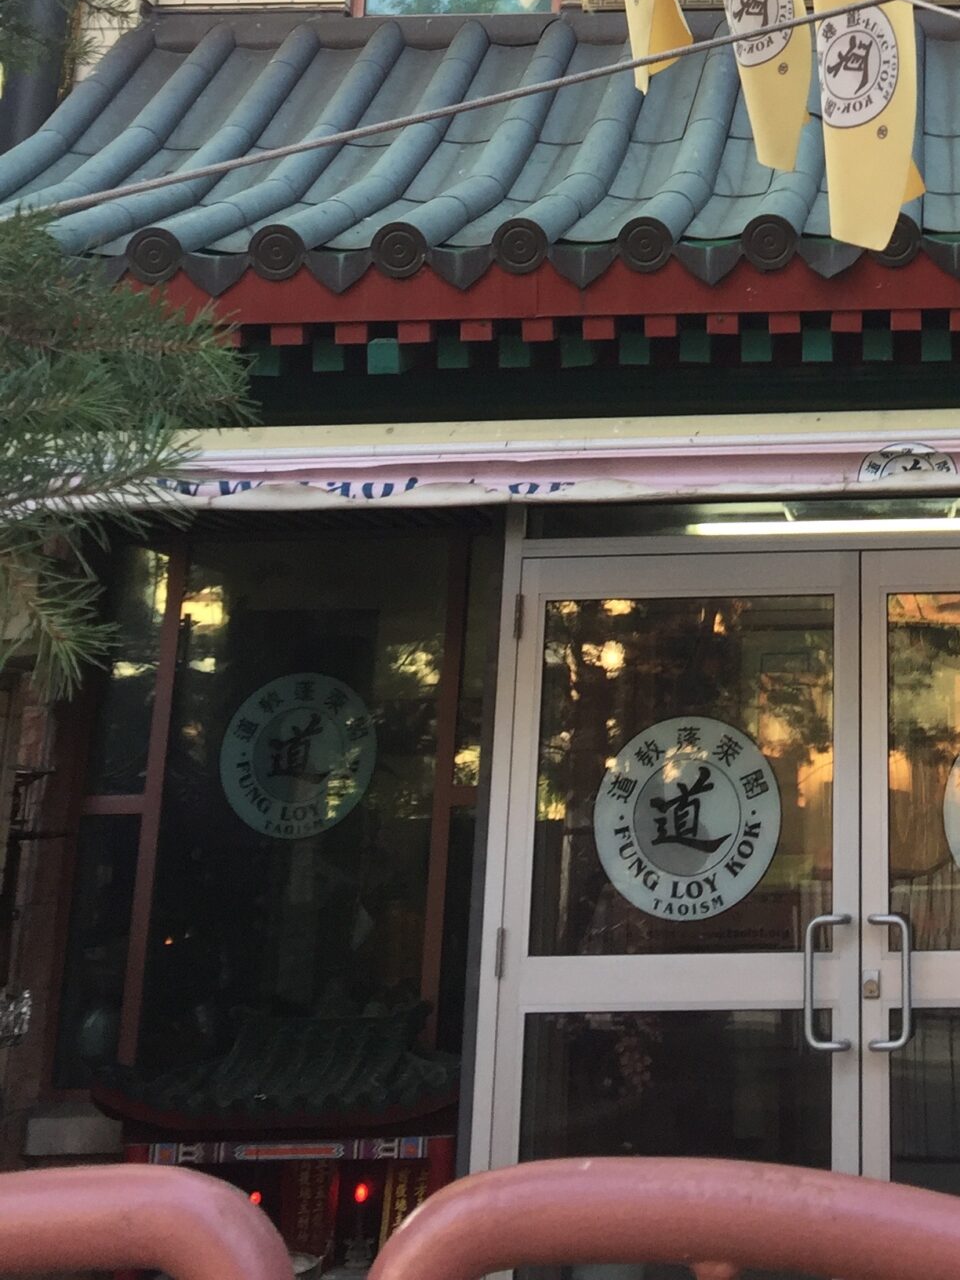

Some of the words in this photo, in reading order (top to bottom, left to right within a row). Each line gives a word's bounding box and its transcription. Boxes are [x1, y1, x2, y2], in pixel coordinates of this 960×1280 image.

[650, 766, 732, 853] 道
[614, 825, 660, 892] FUNG
[671, 873, 719, 899] LOY
[725, 820, 762, 878] KOK
[653, 895, 724, 916] TAOISM
